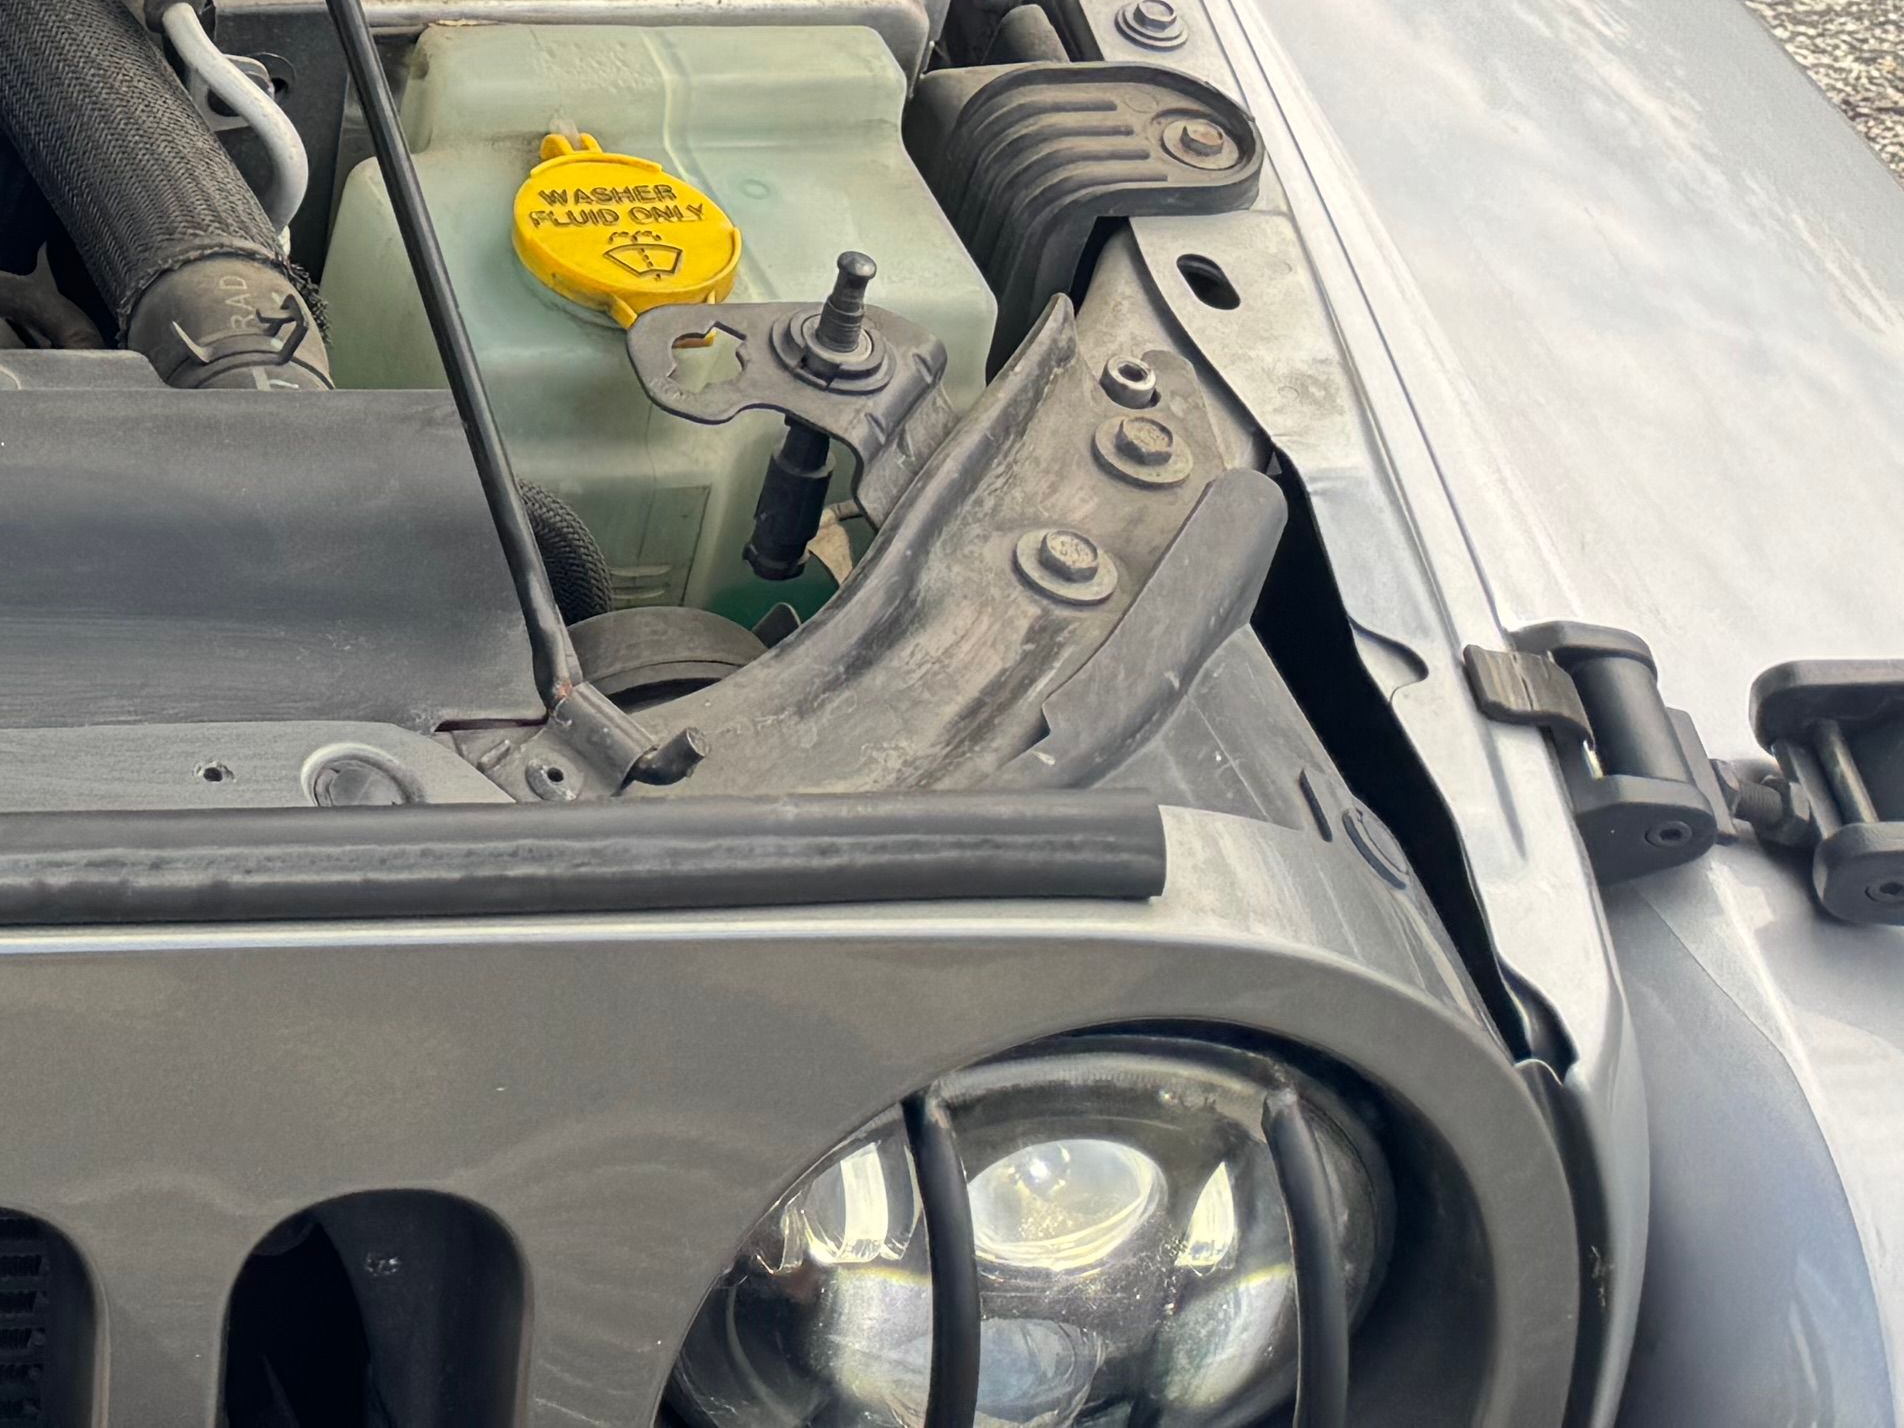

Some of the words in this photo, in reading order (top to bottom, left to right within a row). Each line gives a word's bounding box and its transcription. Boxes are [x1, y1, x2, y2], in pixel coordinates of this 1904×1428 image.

[538, 184, 677, 207] WASHER
[529, 210, 620, 229] FLUID
[629, 203, 704, 225] ONLY
[219, 275, 254, 330] RAD
